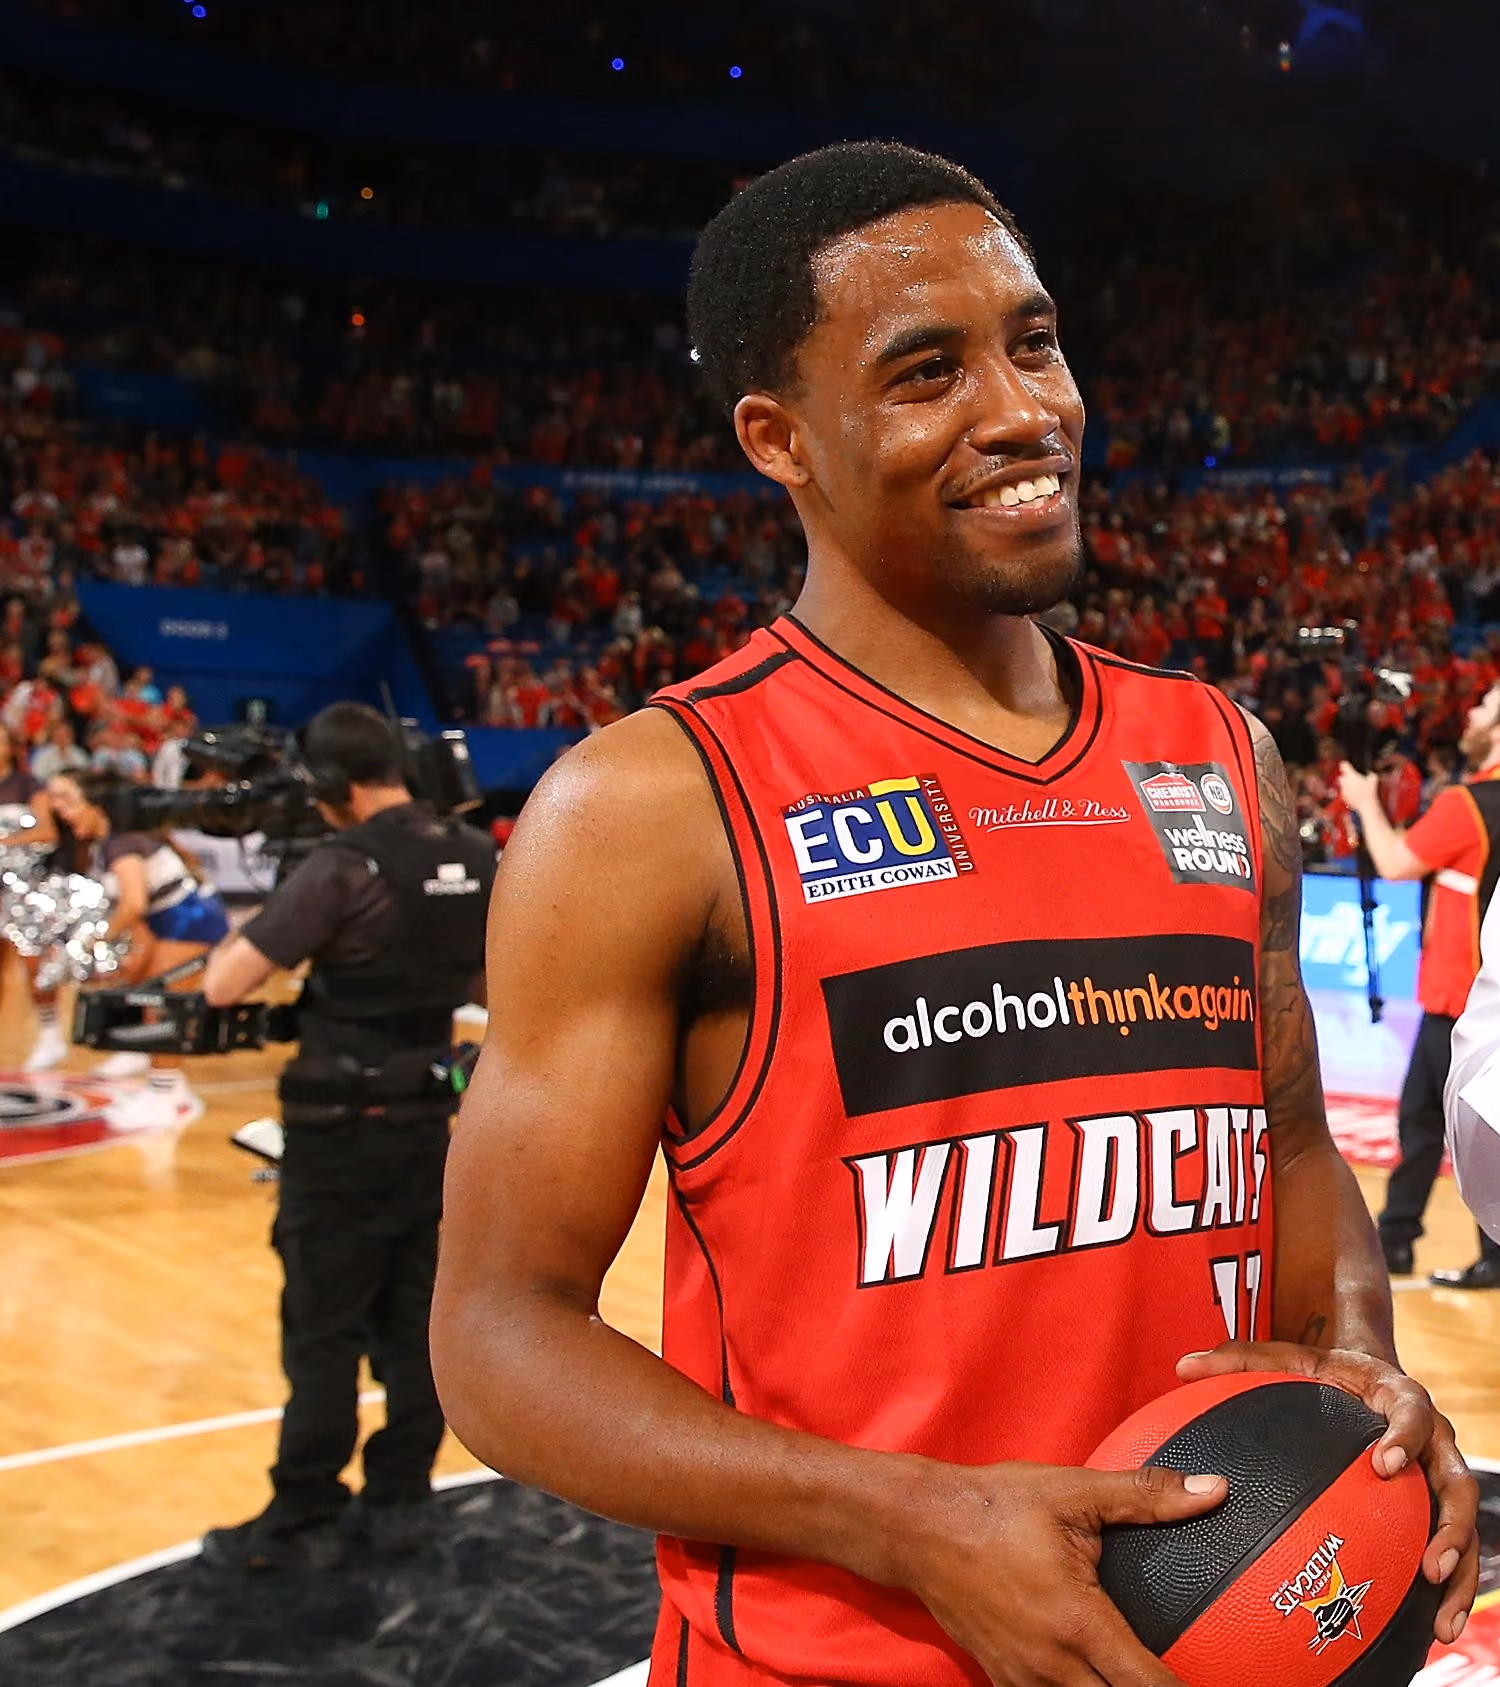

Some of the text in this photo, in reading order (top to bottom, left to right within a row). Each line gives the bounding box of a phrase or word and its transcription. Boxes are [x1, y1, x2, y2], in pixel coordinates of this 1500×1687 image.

[788, 790, 865, 813] AUSTRALIA
[1146, 785, 1196, 799] CHEMIST
[922, 779, 974, 871] UNIVERSITY
[968, 799, 1131, 827] Mitchell & Ness
[785, 794, 937, 875] ECU
[1163, 814, 1247, 855] wellness
[807, 861, 952, 899] EDITH COWAN
[1172, 847, 1251, 879] ROUND
[843, 1105, 1268, 1288] WILDCATS
[1274, 1532, 1344, 1616] WILDCATS
[1308, 1569, 1332, 1598] PERTH
